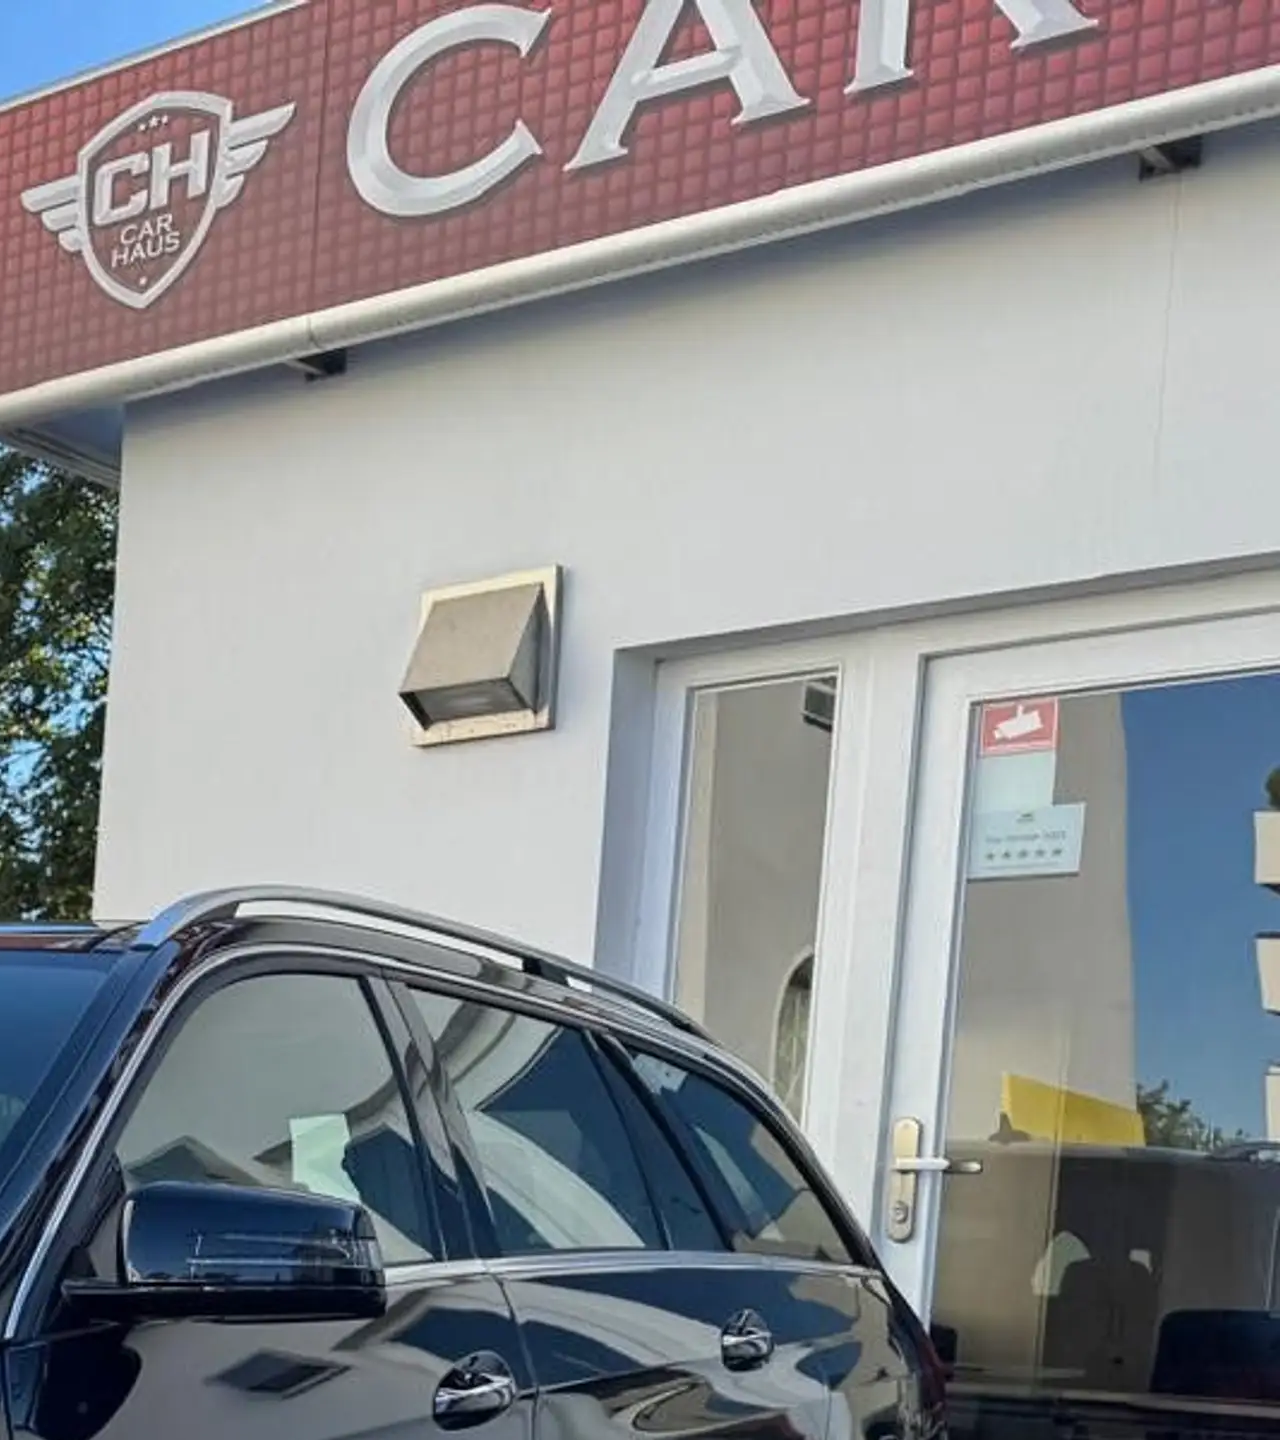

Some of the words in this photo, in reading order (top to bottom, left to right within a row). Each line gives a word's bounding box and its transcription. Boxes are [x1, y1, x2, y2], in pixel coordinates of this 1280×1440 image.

[92, 129, 211, 227] CH
[120, 213, 174, 246] CAR
[110, 231, 181, 269] HAUS
